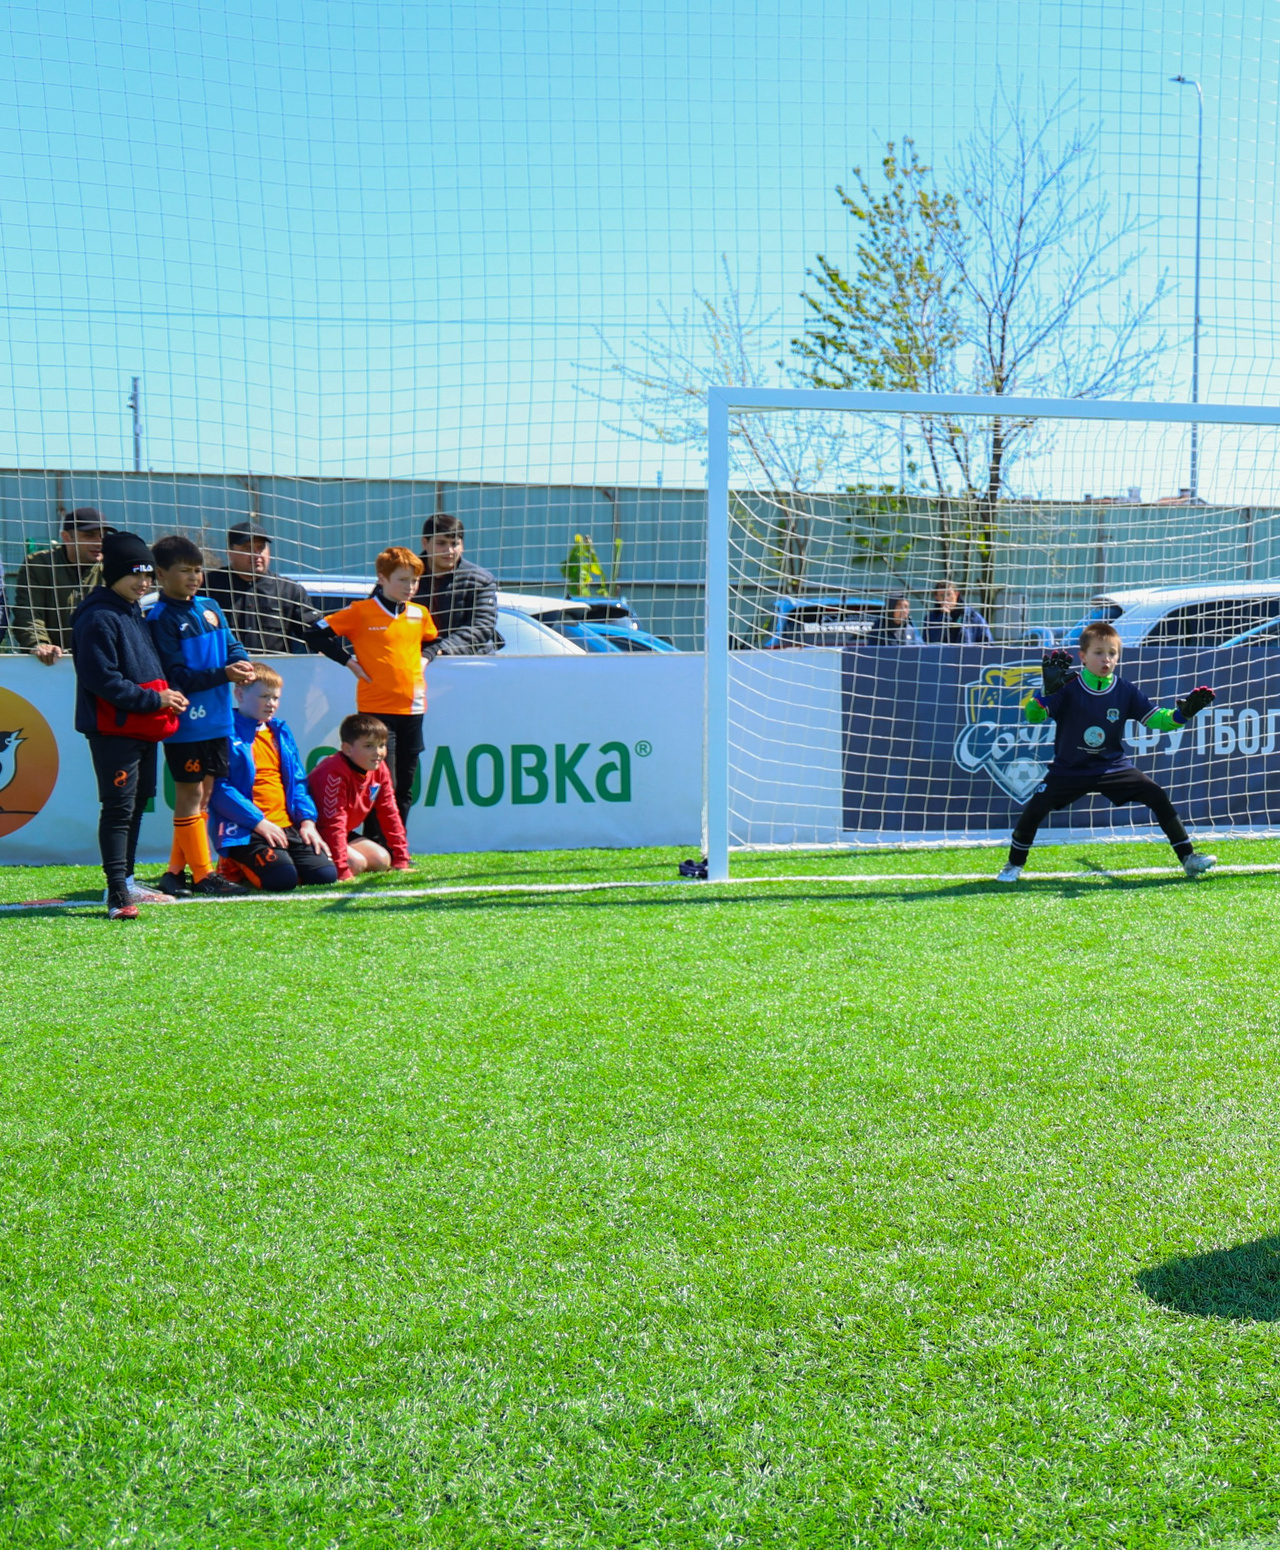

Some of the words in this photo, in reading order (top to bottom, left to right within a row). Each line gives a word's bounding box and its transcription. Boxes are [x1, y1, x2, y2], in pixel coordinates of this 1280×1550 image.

[132, 564, 154, 573] FILA
[189, 704, 206, 720] 66
[184, 758, 201, 773] 66
[112, 769, 128, 788] 8
[217, 821, 239, 837] 18
